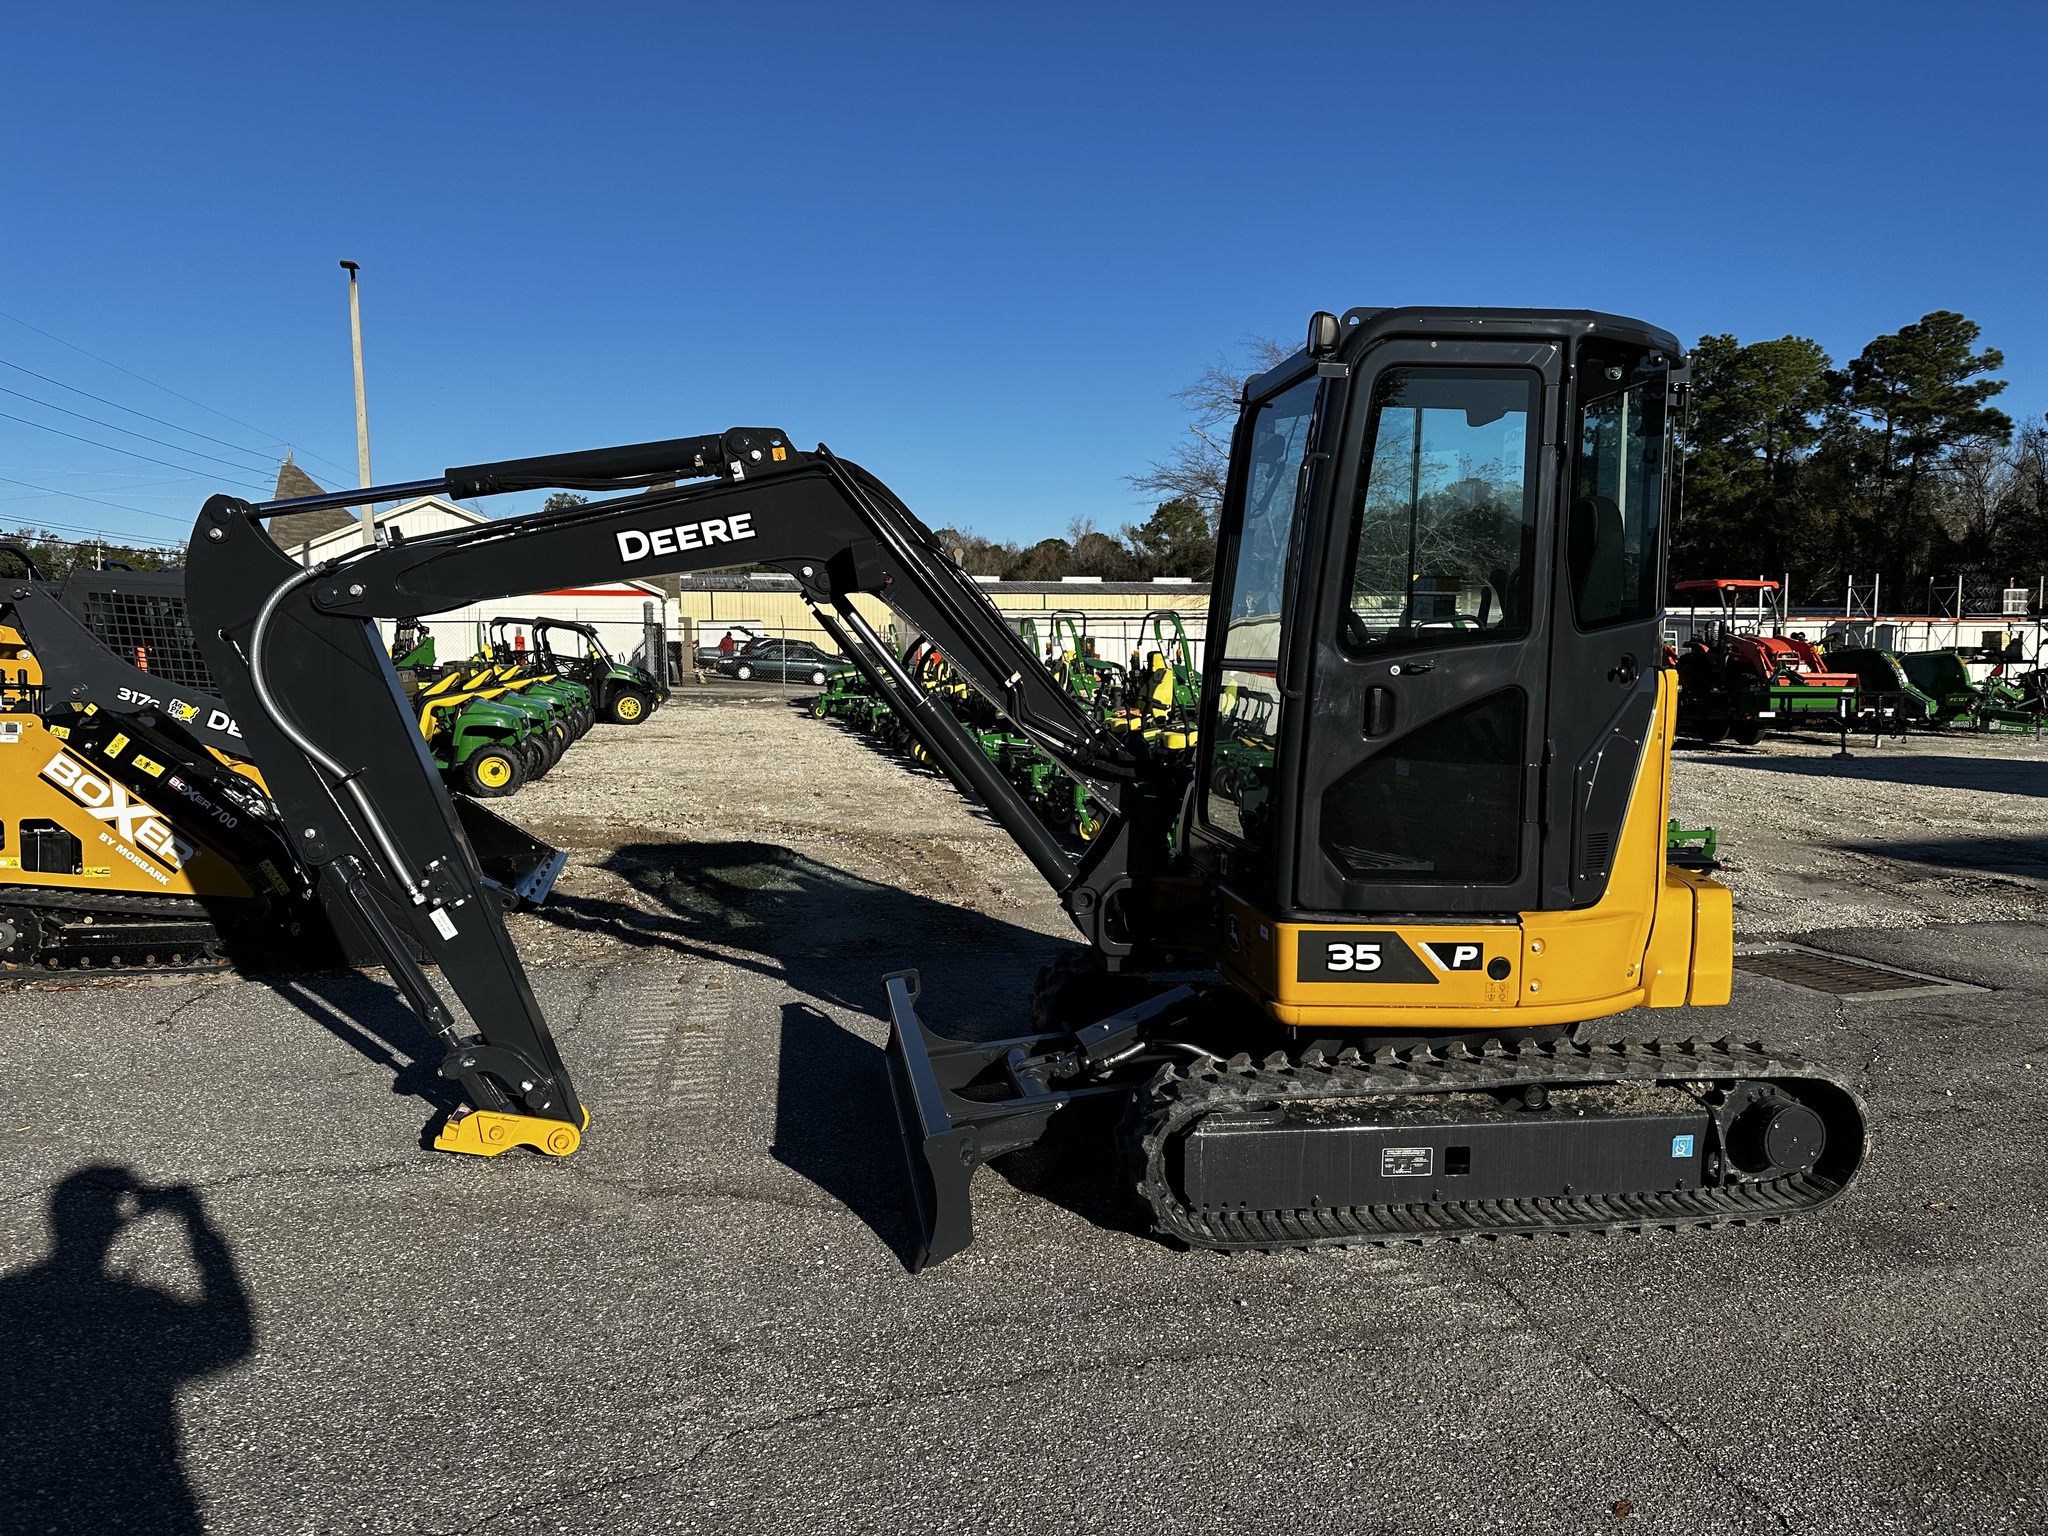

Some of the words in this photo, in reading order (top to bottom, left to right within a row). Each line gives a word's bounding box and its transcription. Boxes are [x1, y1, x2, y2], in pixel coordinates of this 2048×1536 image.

[616, 512, 755, 562] DEERE
[170, 706, 184, 715] Pro
[42, 752, 194, 869] BOXER
[169, 776, 211, 809] BOXER
[211, 806, 237, 829] 700
[98, 832, 116, 846] BY
[115, 844, 171, 885] MORBARK
[1327, 944, 1381, 971] 35
[1453, 945, 1478, 967] P
